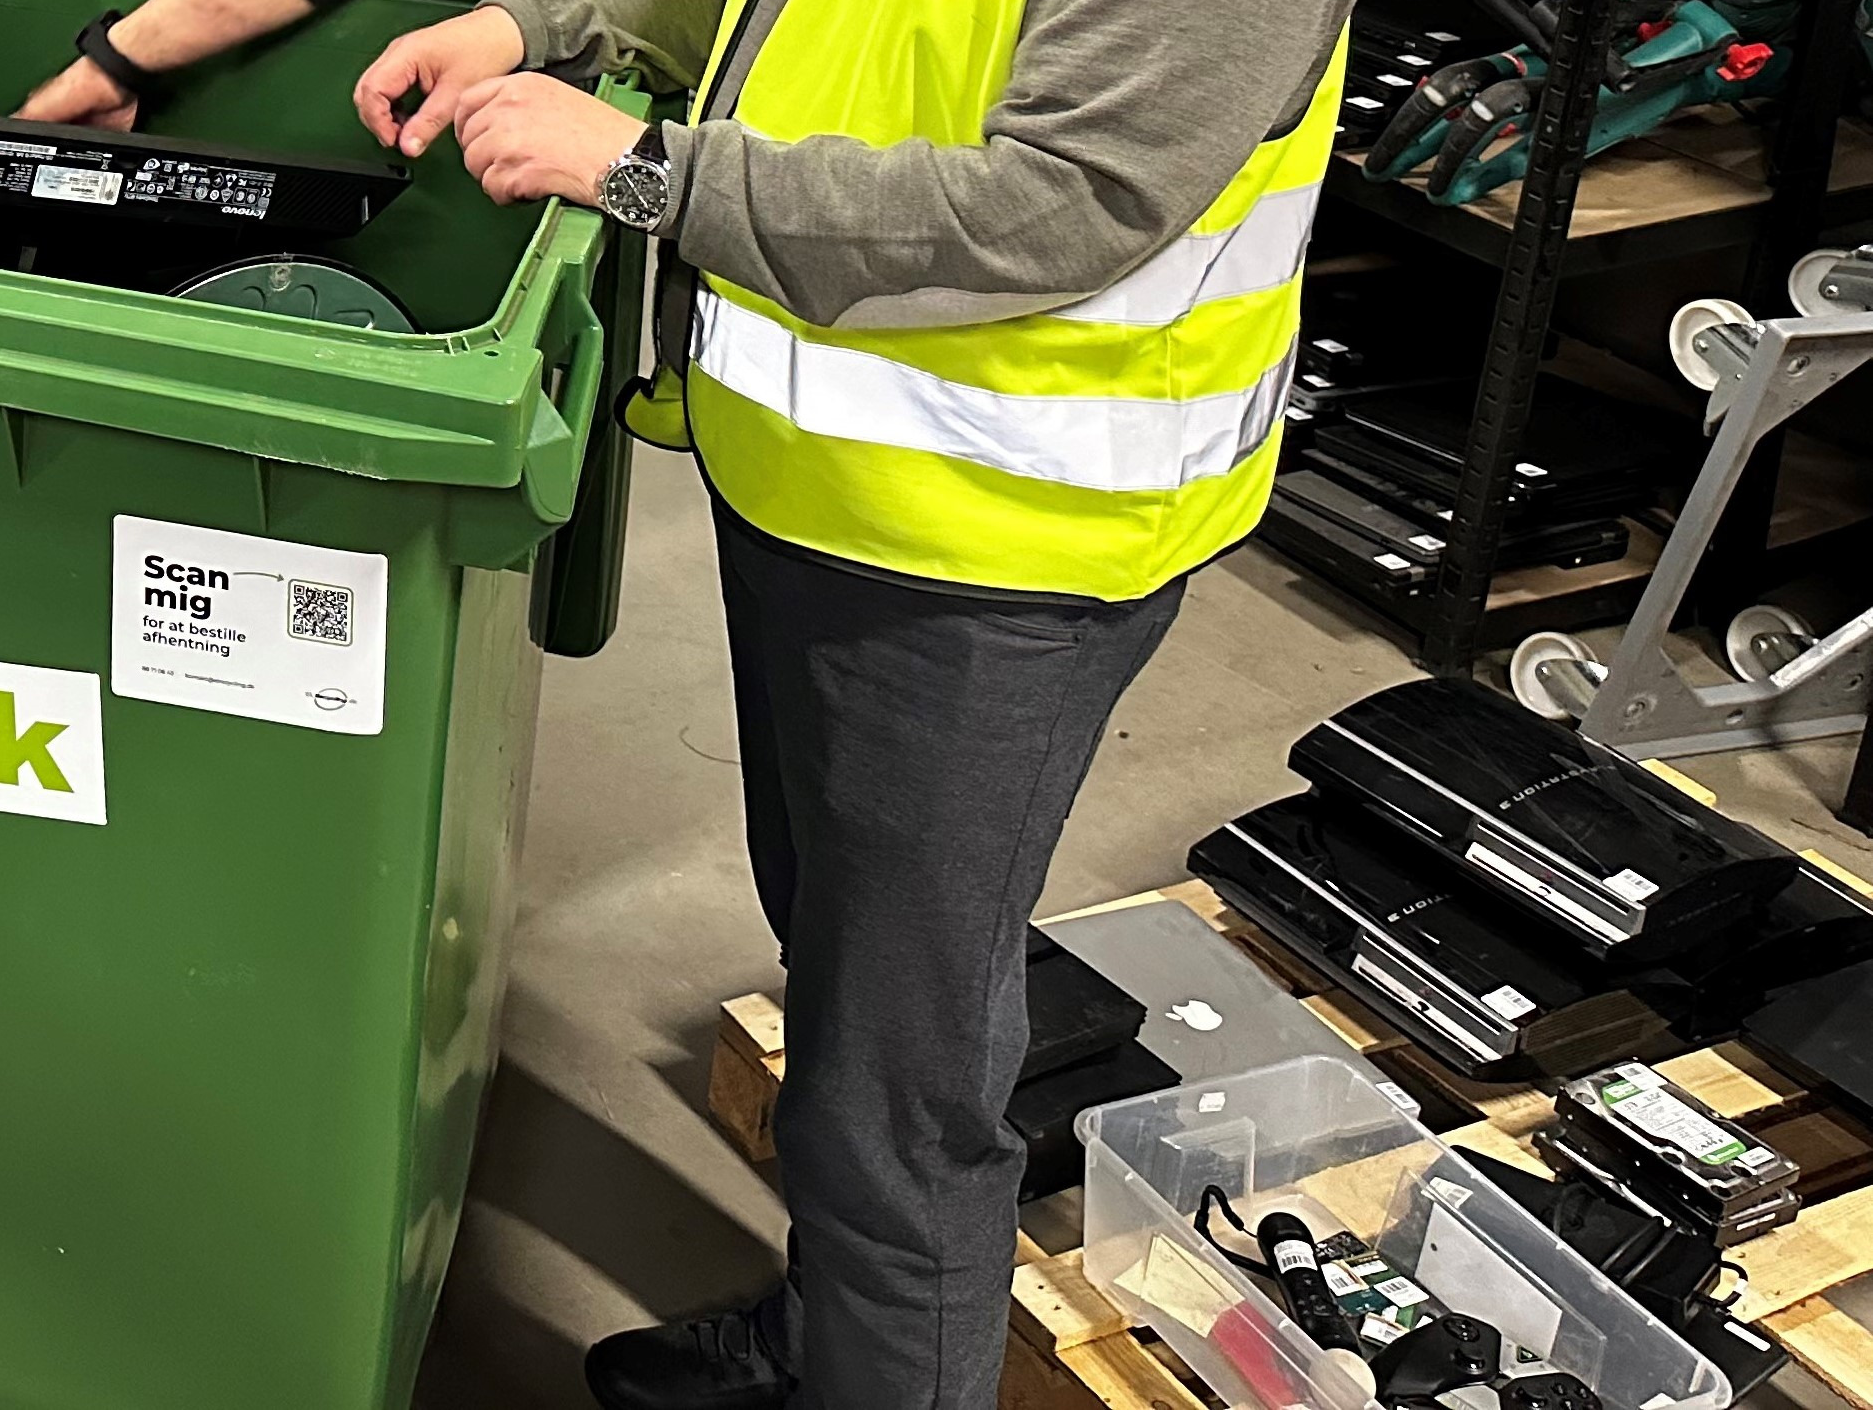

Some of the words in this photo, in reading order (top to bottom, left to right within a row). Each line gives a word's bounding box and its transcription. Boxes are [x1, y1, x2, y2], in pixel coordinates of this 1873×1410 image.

[221, 205, 267, 220] lenovo
[144, 555, 229, 591] Scan
[144, 584, 211, 620] mig
[143, 615, 164, 629] for
[169, 622, 185, 632] at
[189, 622, 246, 643] bestille
[143, 631, 230, 658] afhentning
